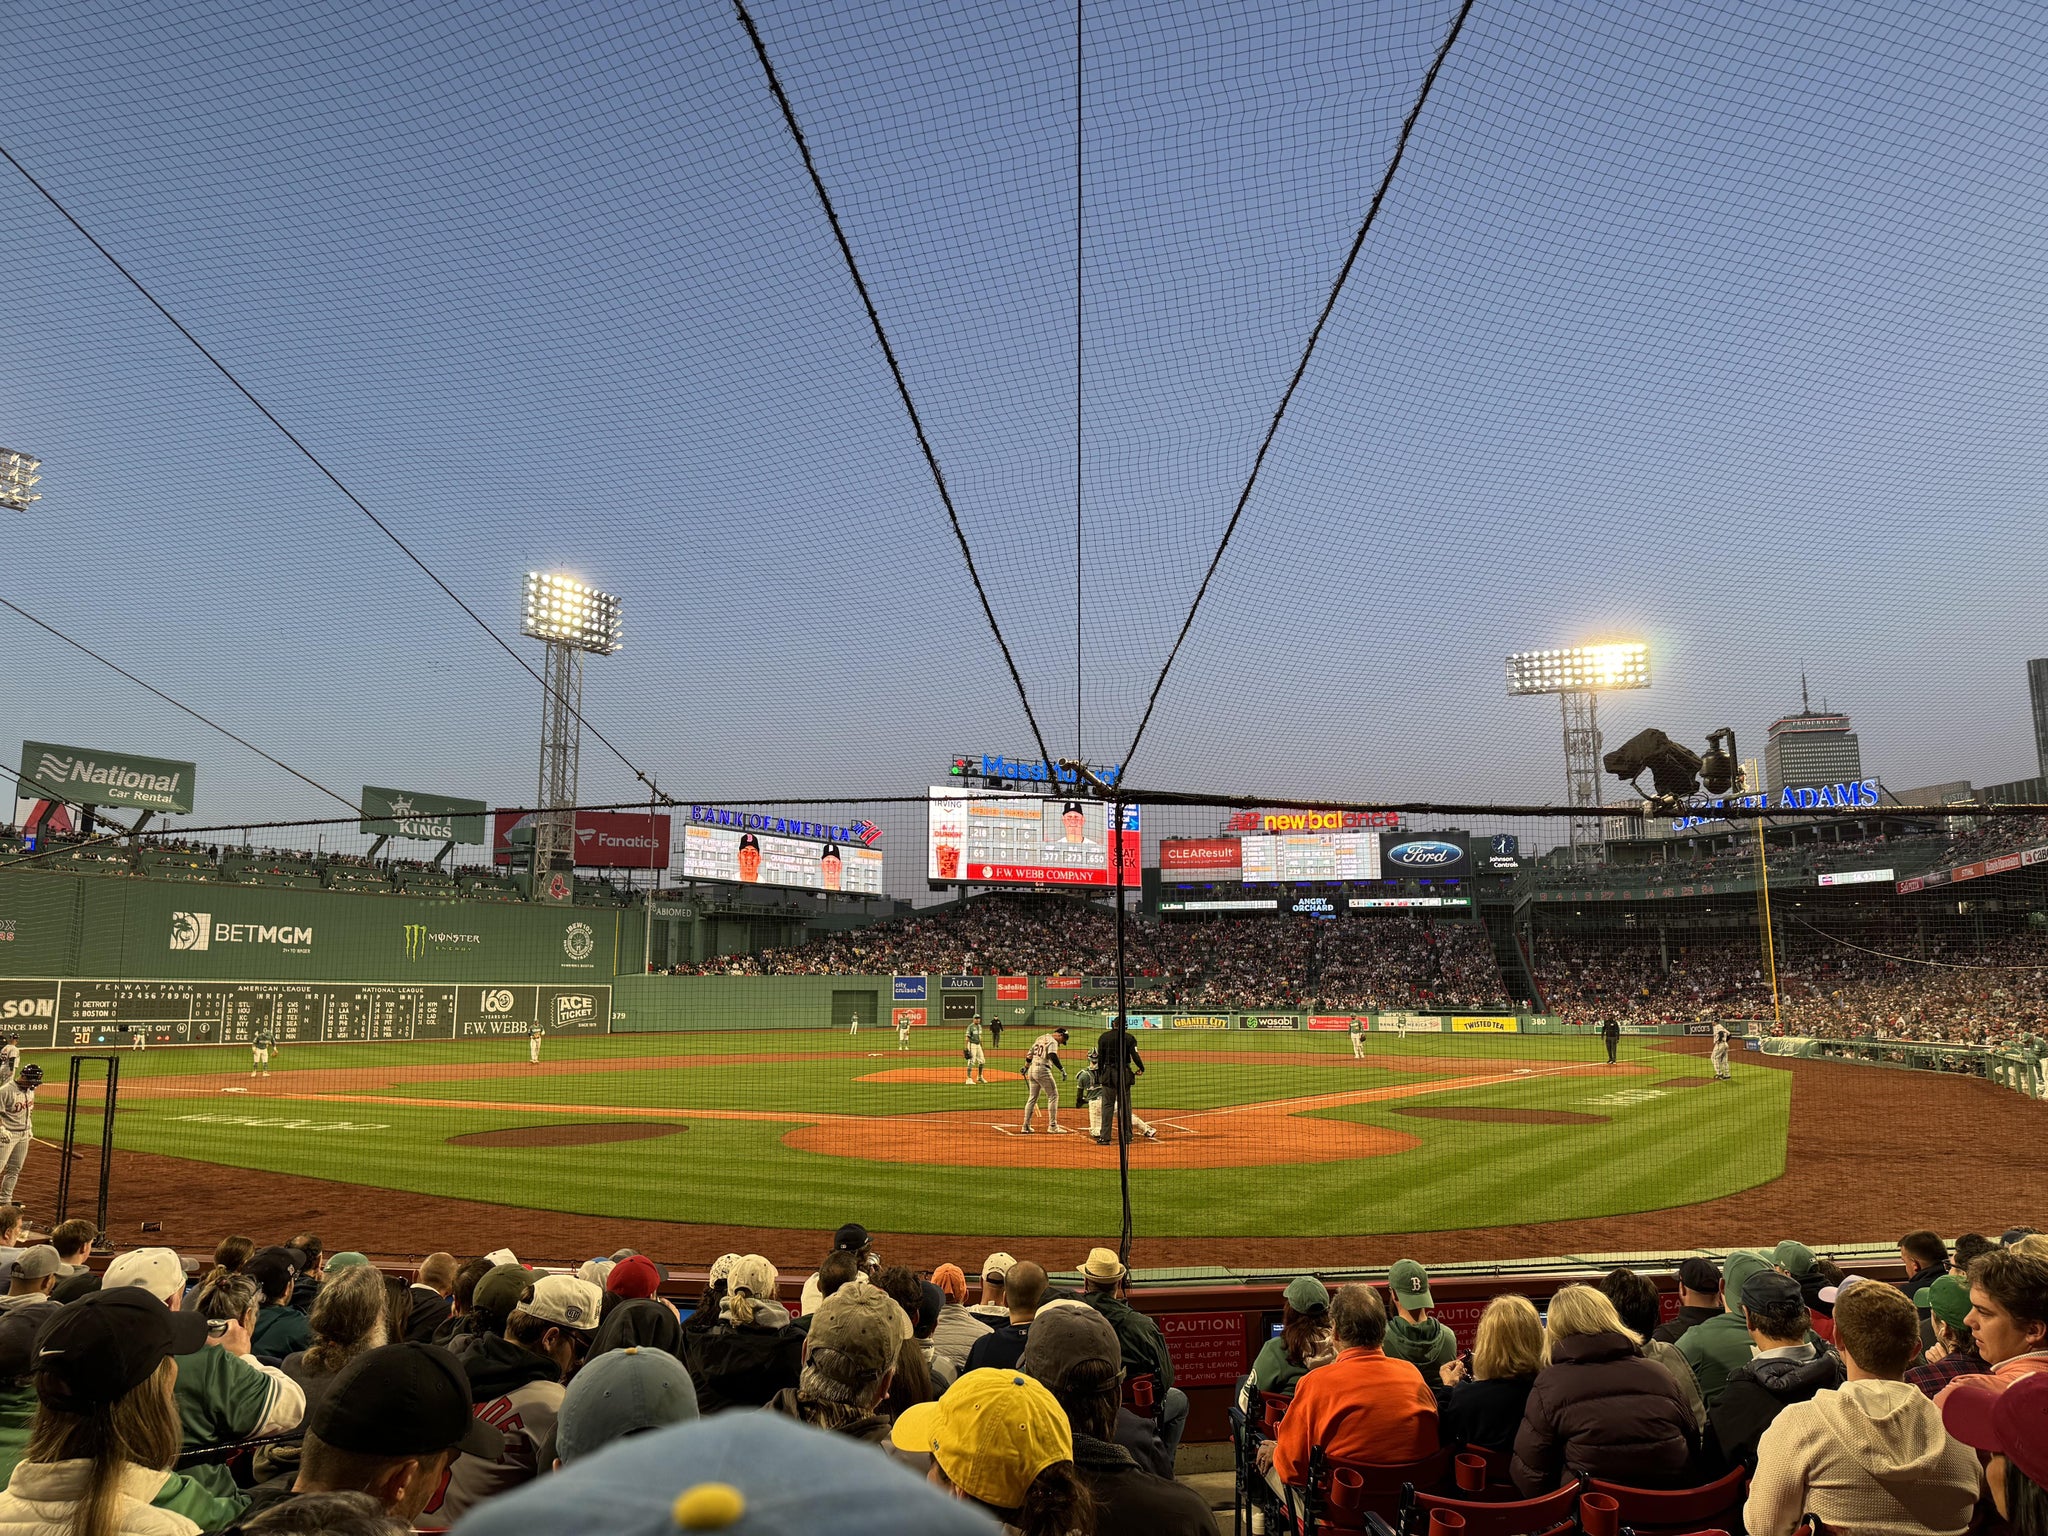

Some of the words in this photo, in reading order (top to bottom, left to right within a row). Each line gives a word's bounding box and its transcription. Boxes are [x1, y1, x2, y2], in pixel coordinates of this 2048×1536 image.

[69, 760, 180, 792] National
[108, 788, 130, 798] Car
[134, 791, 173, 803] Rental
[1780, 779, 1879, 809] ADAMS
[934, 799, 962, 808] IRVING
[691, 805, 743, 827] BANK
[750, 813, 771, 830] OF
[776, 818, 850, 842] AMERICA
[1264, 813, 1306, 831] new
[1308, 809, 1399, 829] balance
[399, 821, 452, 838] KINGS
[1024, 831, 1029, 839] 6
[598, 832, 659, 849] Fanatics
[1041, 853, 1058, 861] .377
[1064, 854, 1082, 862] .273
[1087, 855, 1104, 863] .650
[1113, 848, 1135, 858] SAT
[1168, 847, 1233, 859] CLEAResult
[1402, 845, 1448, 862] Ford
[806, 874, 812, 885] 2
[996, 868, 1013, 877] F.W.
[1016, 869, 1044, 879] WEBB
[1046, 870, 1094, 880] COMPANY
[655, 906, 692, 918] ABIOMED
[1292, 904, 1334, 912] ORCHARD
[214, 922, 313, 945] BETMGM
[428, 932, 481, 944] MONSTER
[95, 983, 151, 991] FENWAY
[997, 983, 1027, 991] Safelite
[1060, 979, 1081, 987] TICKET
[480, 989, 514, 1013] 160
[559, 996, 592, 1011] ACE
[560, 1008, 592, 1021] TICKET
[28, 1023, 49, 1031] 1898
[1174, 1016, 1208, 1027] GRANITE
[1209, 1016, 1227, 1028] CITY
[1258, 1016, 1293, 1026] wasabi
[1463, 1021, 1492, 1030] TWISTED
[1492, 1021, 1504, 1030] TEA
[463, 1022, 487, 1035] F.W.
[490, 1021, 528, 1034] WEBB
[74, 1033, 90, 1044] 20
[1034, 1044, 1044, 1057] 20
[1410, 1276, 1421, 1291] B
[1165, 1319, 1240, 1332] CAUTION!
[1207, 1361, 1238, 1369] LEAVING
